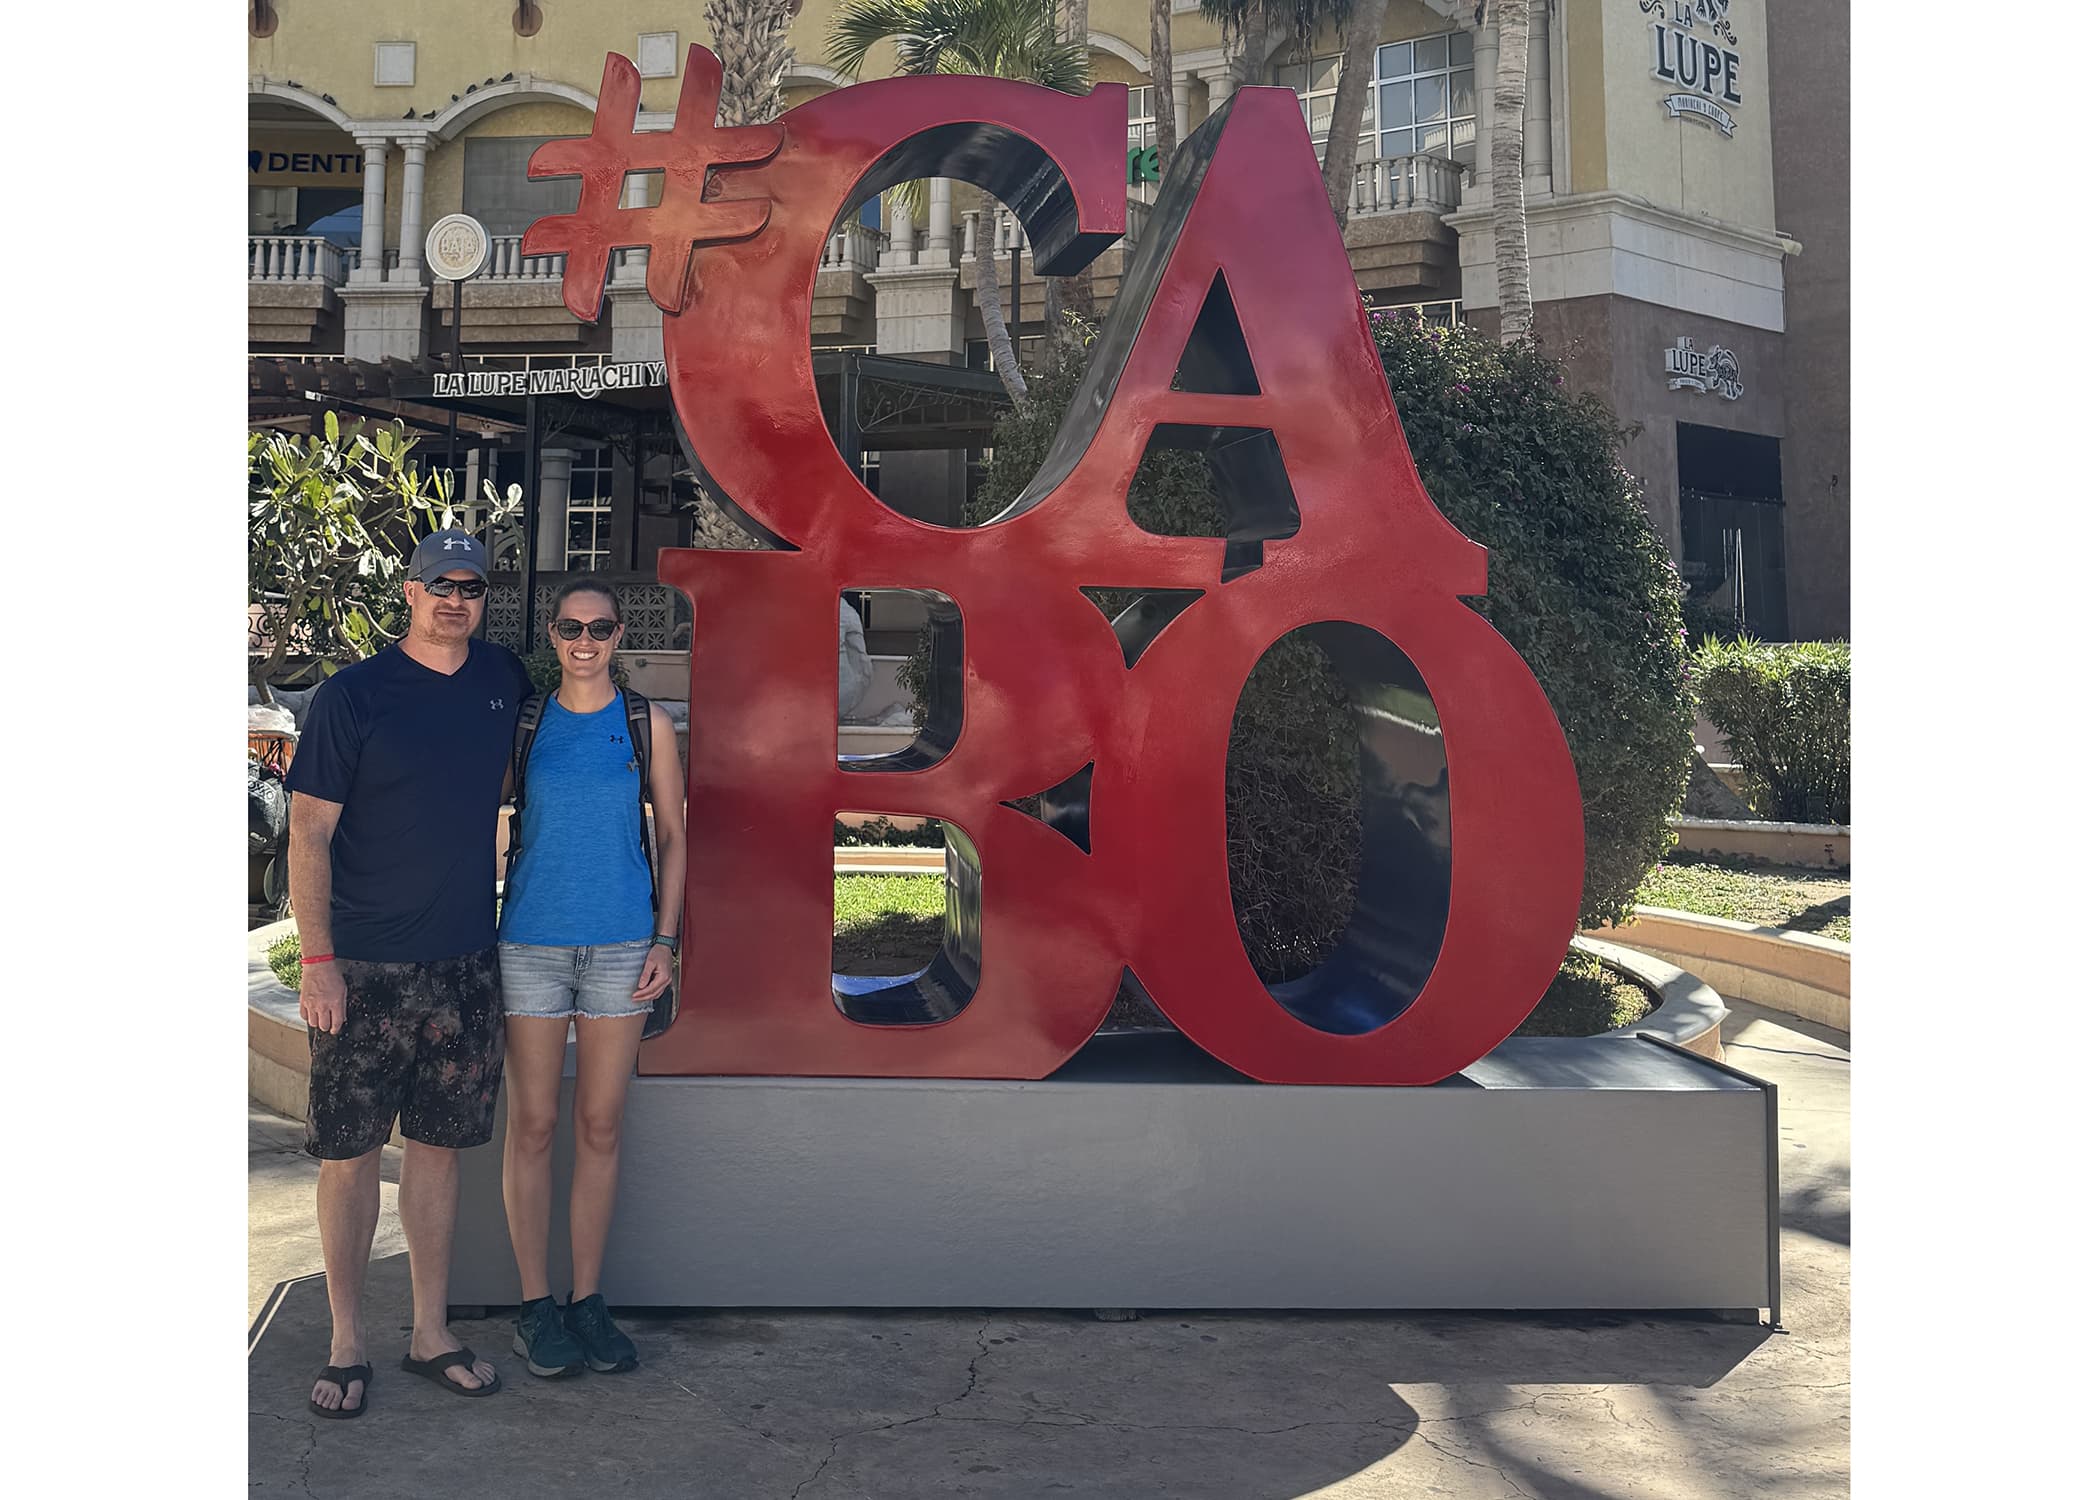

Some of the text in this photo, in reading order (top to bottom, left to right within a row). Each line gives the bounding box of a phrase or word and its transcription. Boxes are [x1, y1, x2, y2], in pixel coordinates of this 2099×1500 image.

[1674, 0, 1694, 28] LA
[1654, 24, 1742, 105] LUPE
[1683, 336, 1694, 350] LA
[1671, 348, 1706, 377] LUPE
[433, 361, 665, 399] LA LUPE MARIACHI Y
